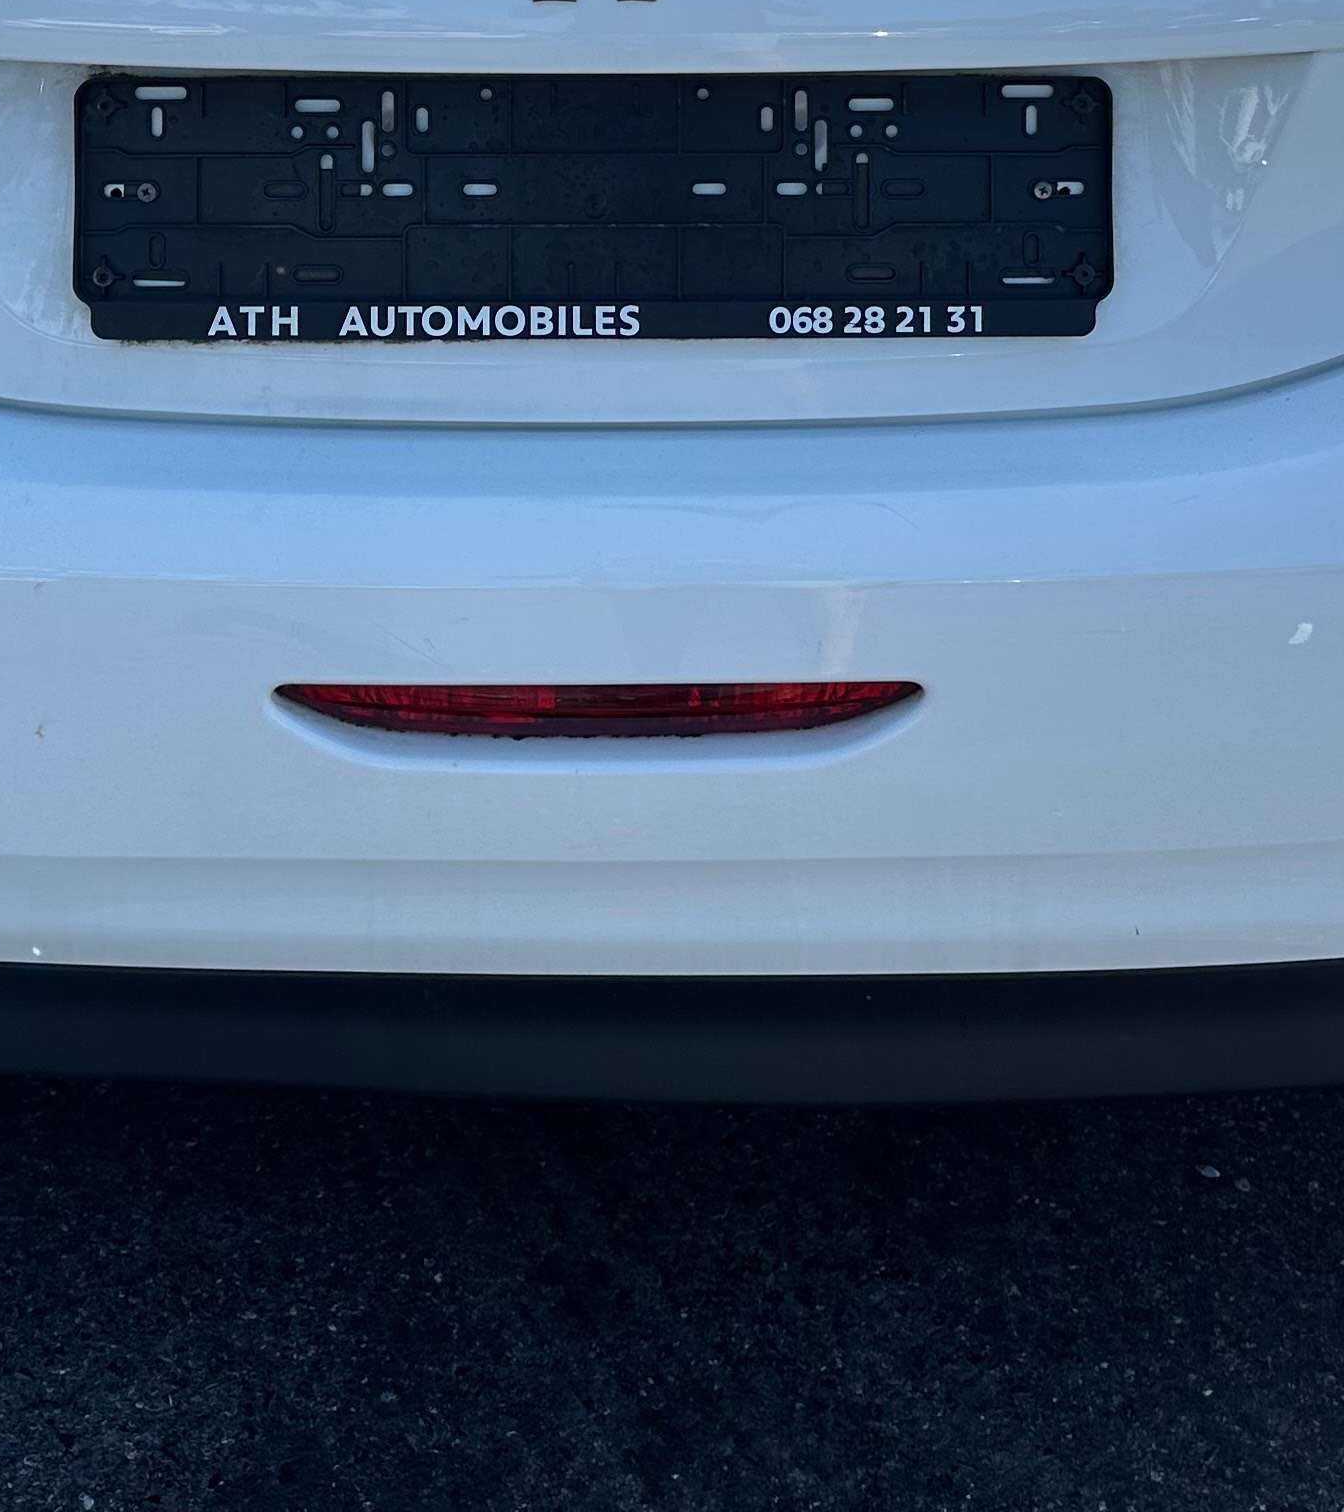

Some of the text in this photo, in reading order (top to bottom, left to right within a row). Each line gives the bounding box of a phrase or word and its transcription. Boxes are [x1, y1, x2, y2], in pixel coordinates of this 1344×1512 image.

[207, 305, 983, 337] ATH AUTOMOBILES 068 28 21 31
